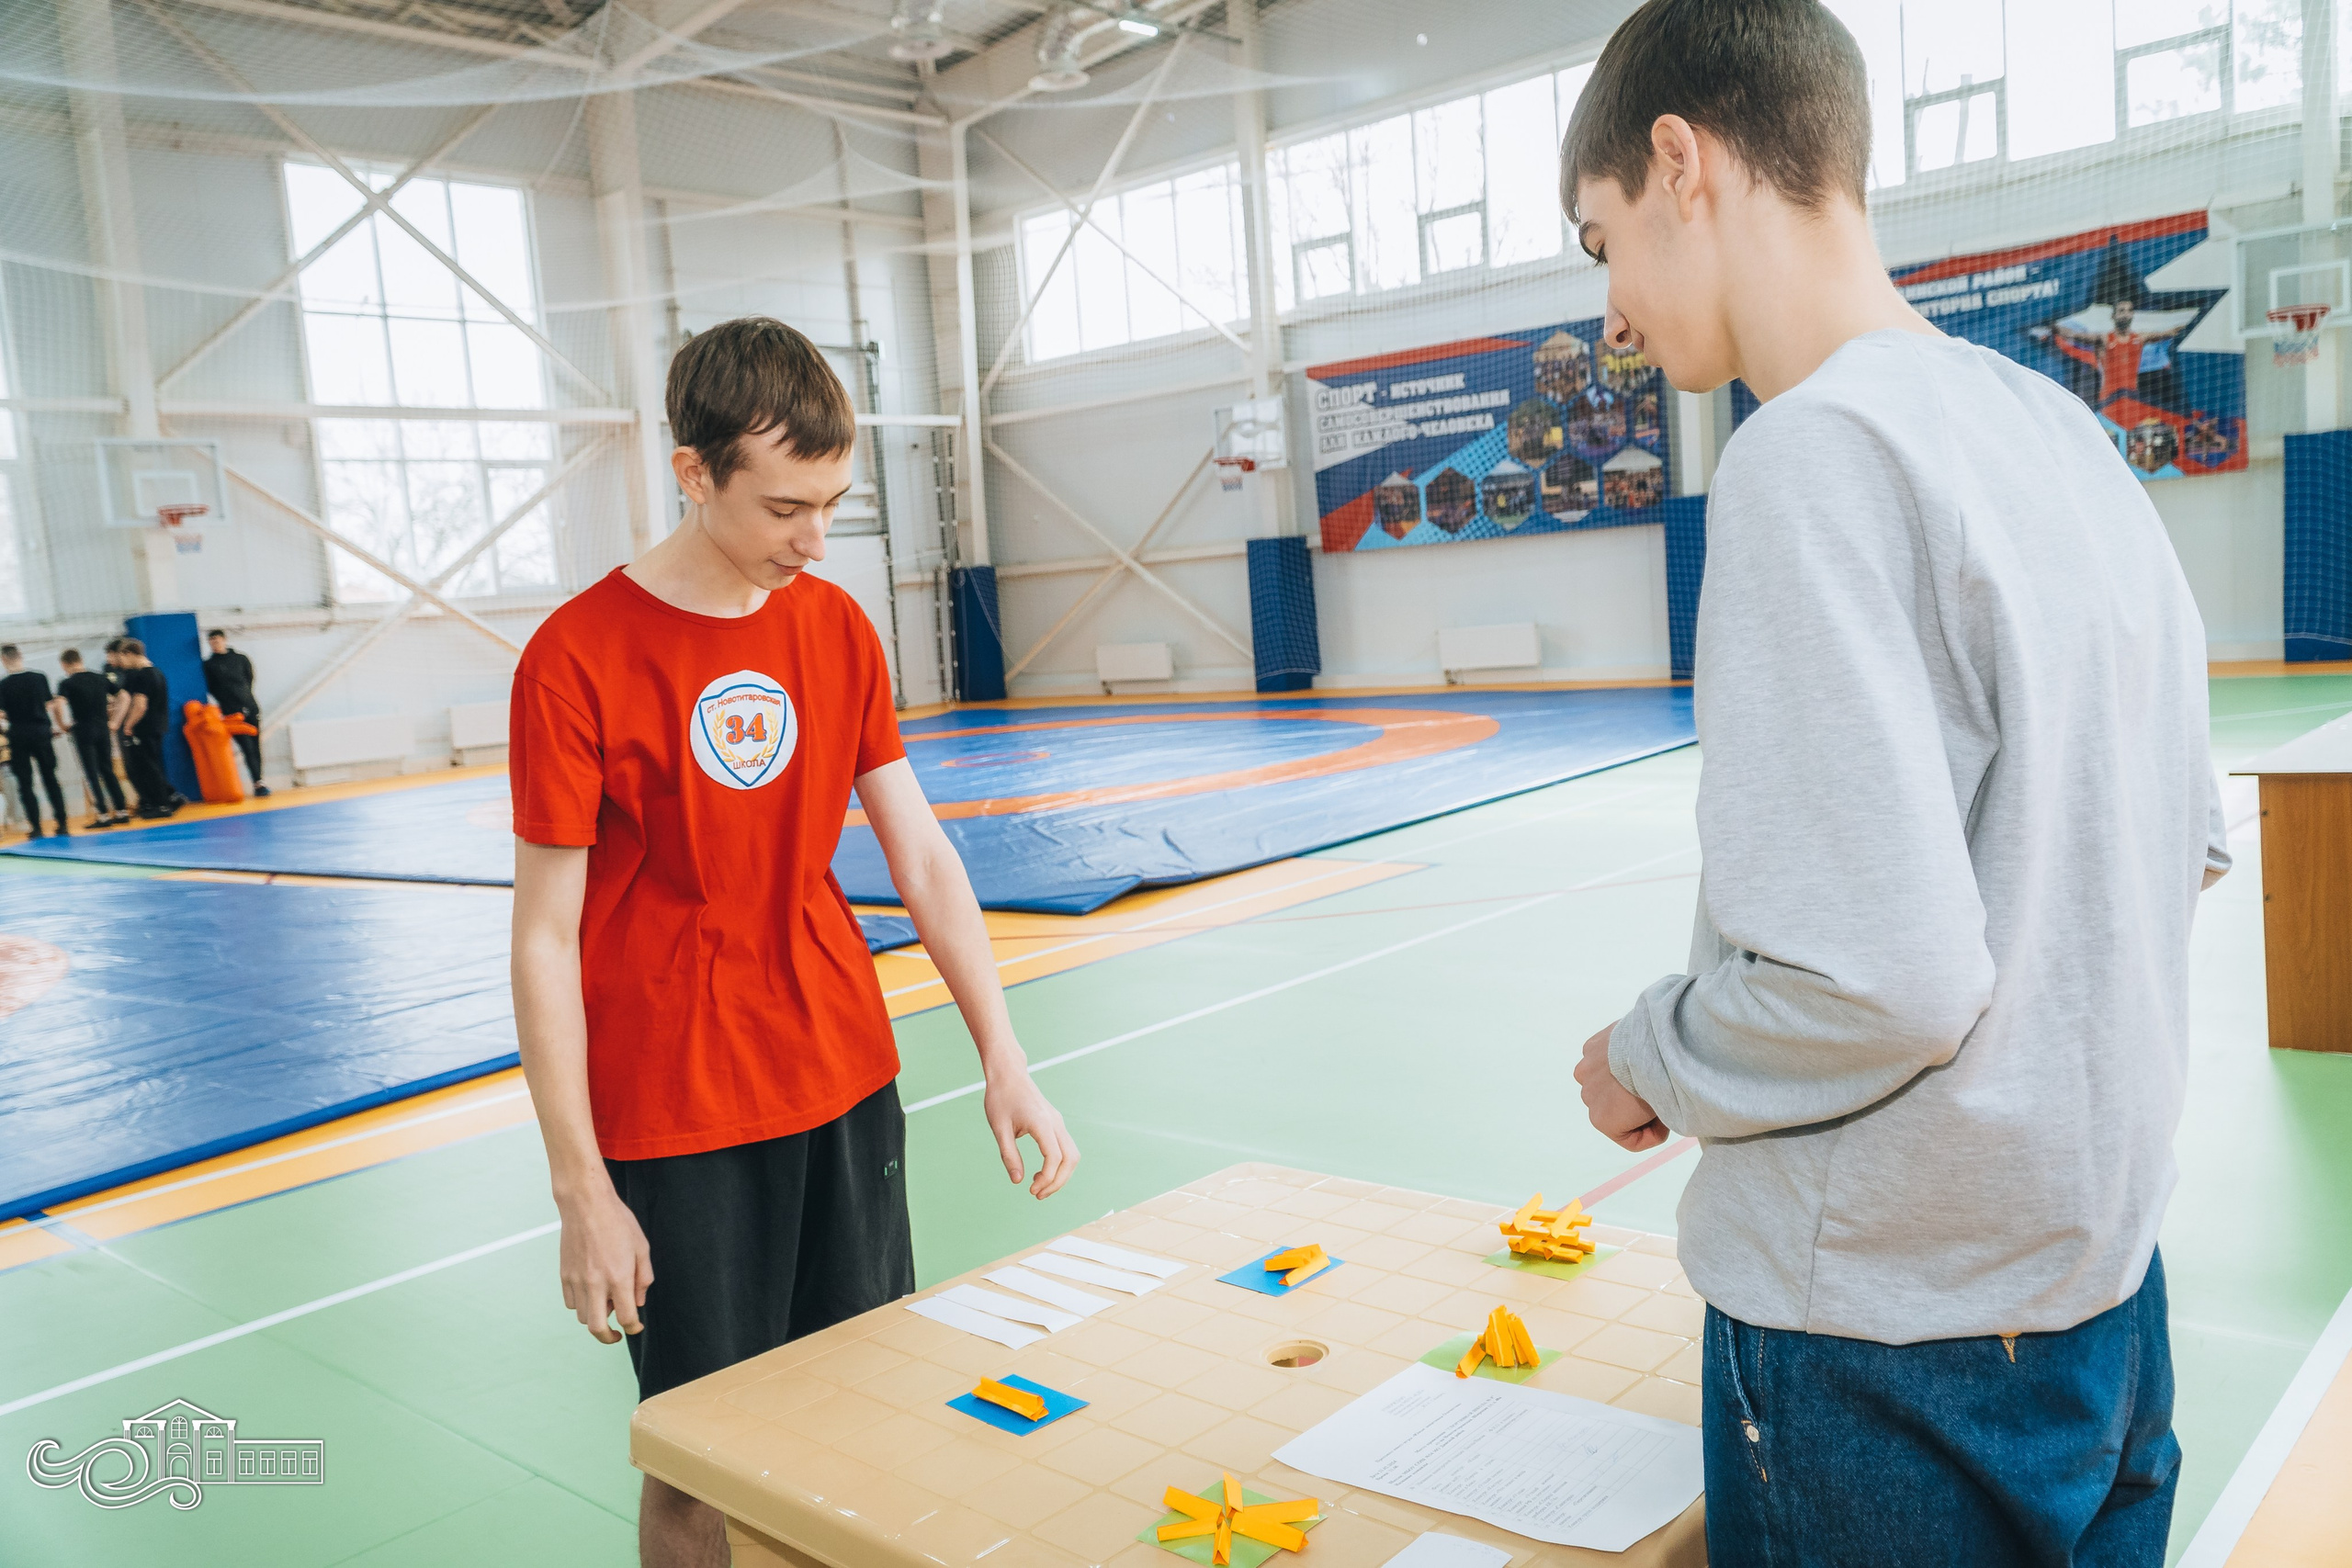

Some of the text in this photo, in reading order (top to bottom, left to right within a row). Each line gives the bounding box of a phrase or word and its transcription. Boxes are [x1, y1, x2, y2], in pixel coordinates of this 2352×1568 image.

[1986, 278, 2059, 306] СПОРТА!
[1317, 381, 1377, 410] СПОРТ
[718, 694, 781, 707] Новотитаровская
[725, 713, 767, 745] 34
[732, 759, 766, 770] ШКОЛА
